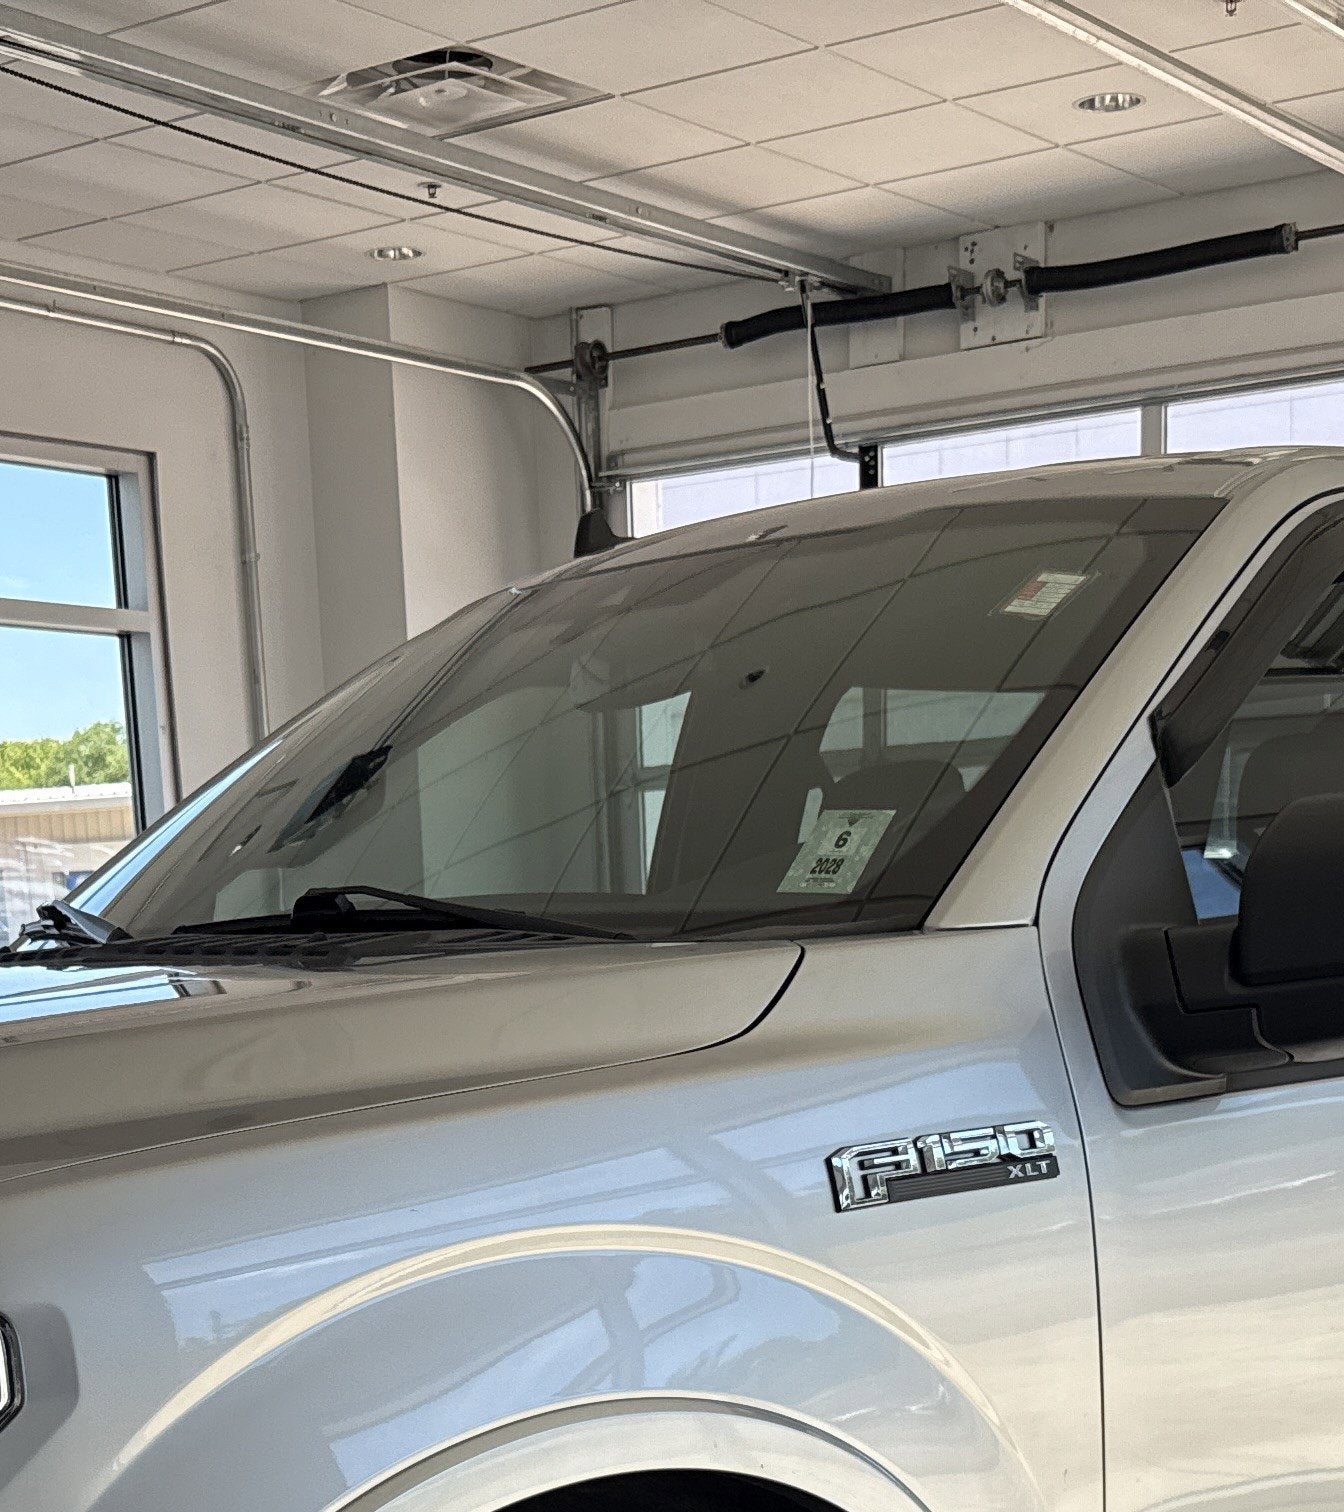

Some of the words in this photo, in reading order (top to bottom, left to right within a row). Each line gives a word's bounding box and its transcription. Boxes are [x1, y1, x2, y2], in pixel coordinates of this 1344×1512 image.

[834, 830, 852, 849] 6
[809, 857, 845, 875] 2028
[1007, 1160, 1051, 1179] XLT
